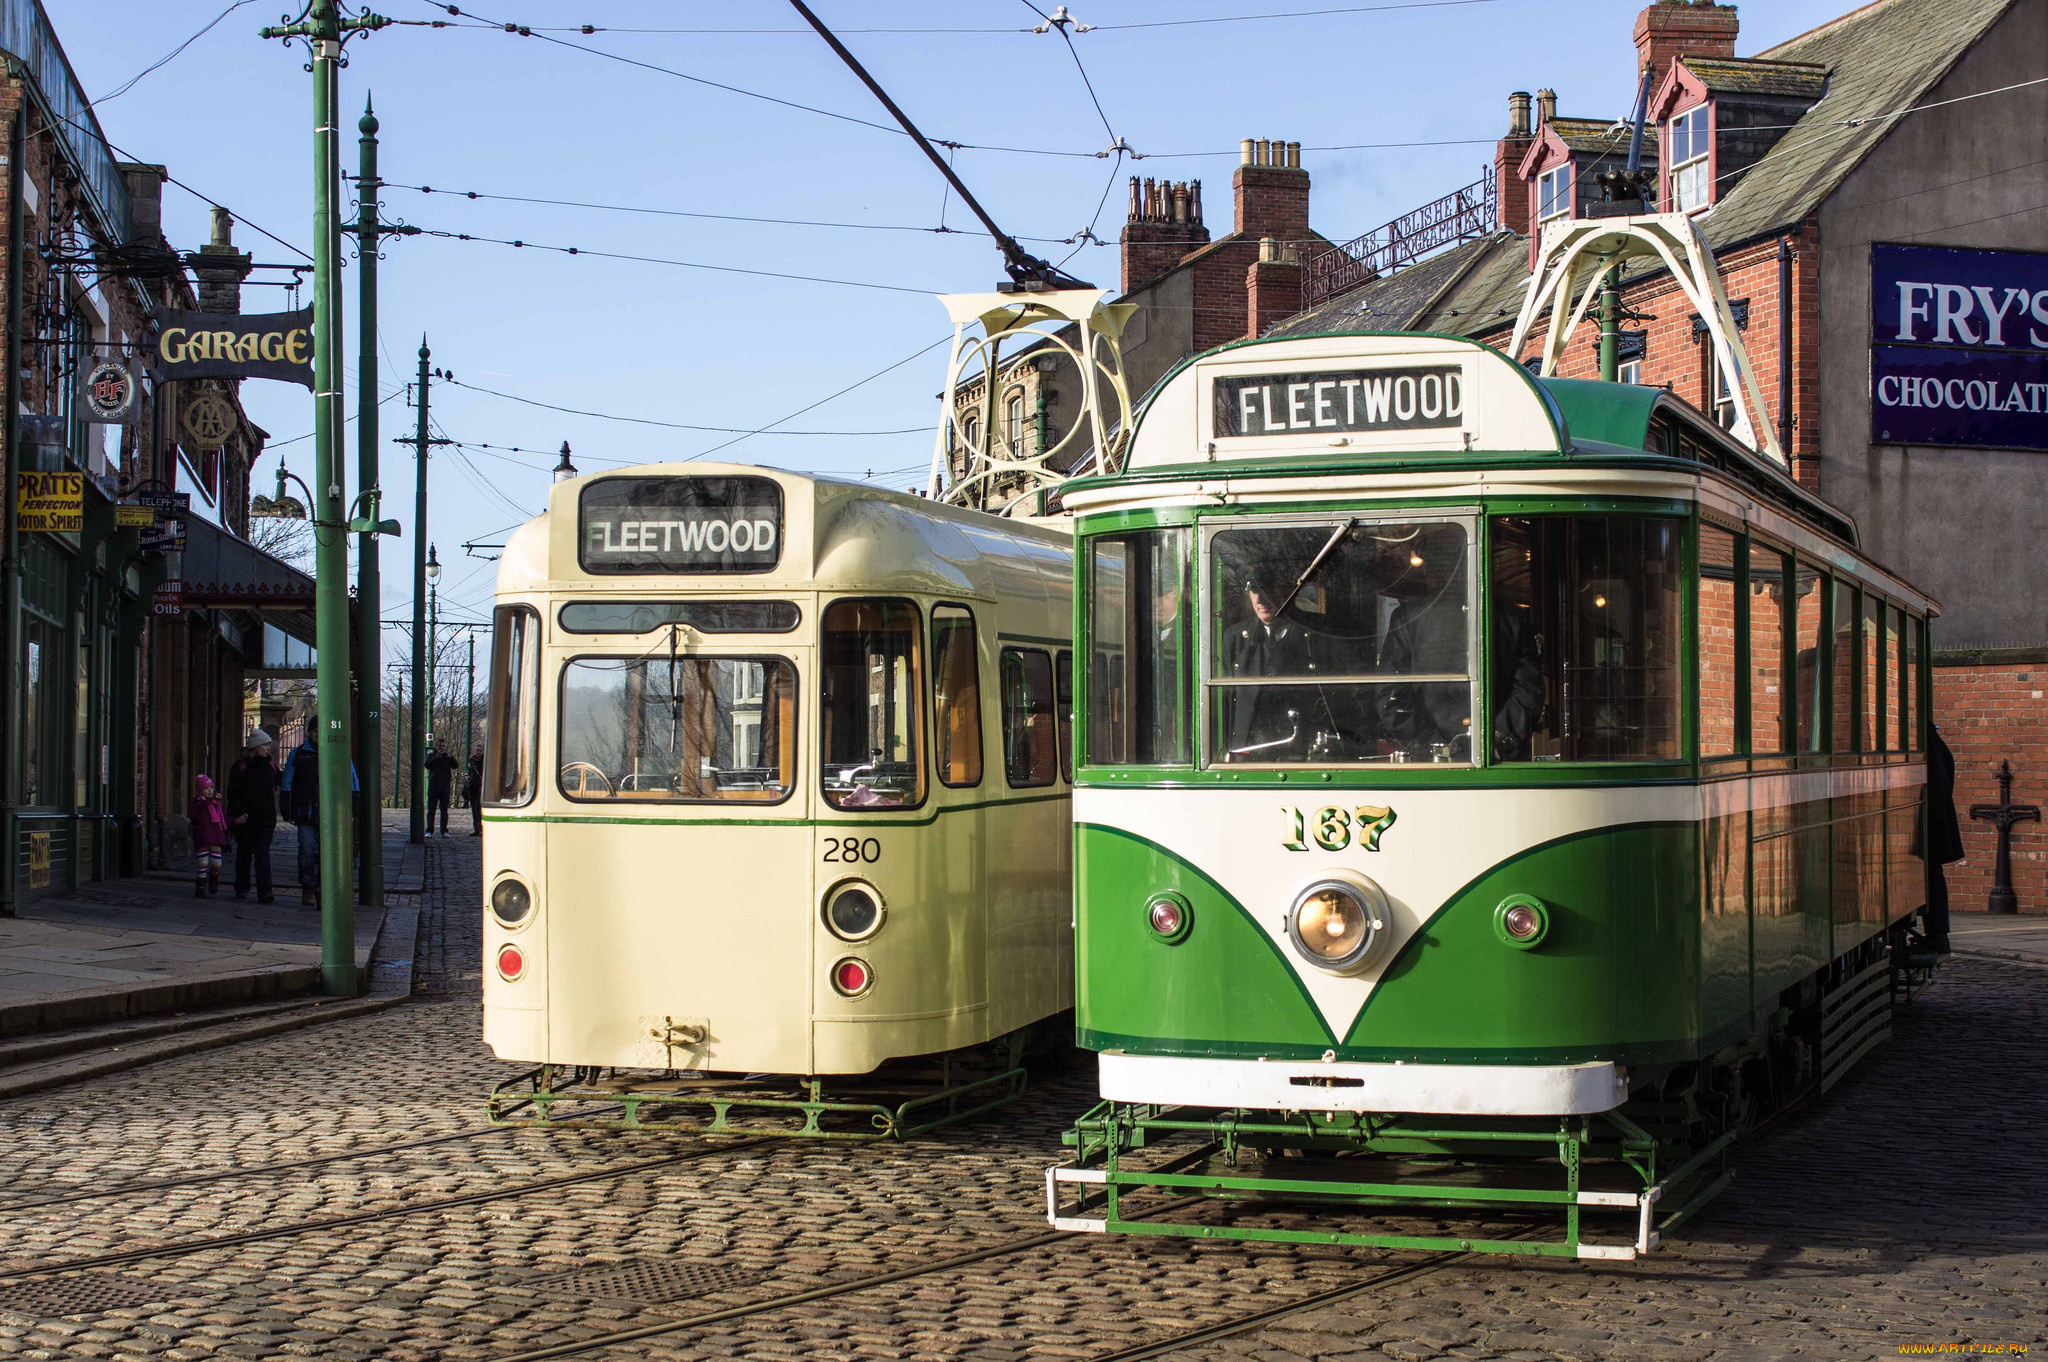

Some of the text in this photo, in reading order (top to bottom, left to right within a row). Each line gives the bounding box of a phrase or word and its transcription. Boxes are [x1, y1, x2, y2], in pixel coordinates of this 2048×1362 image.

[1313, 275, 1330, 298] AND
[160, 327, 309, 364] GARAGE
[93, 379, 127, 401] HF
[1238, 372, 1463, 433] FLEETWOOD
[1878, 375, 2048, 414] CHOCOLAT
[17, 473, 82, 503] PRATT'S
[21, 500, 82, 510] PERFECTION
[17, 512, 47, 529] OTOR
[586, 519, 776, 552] FLEETWOOD
[154, 603, 180, 614] Oils
[1280, 804, 1398, 852] 167
[823, 837, 881, 864] 280
